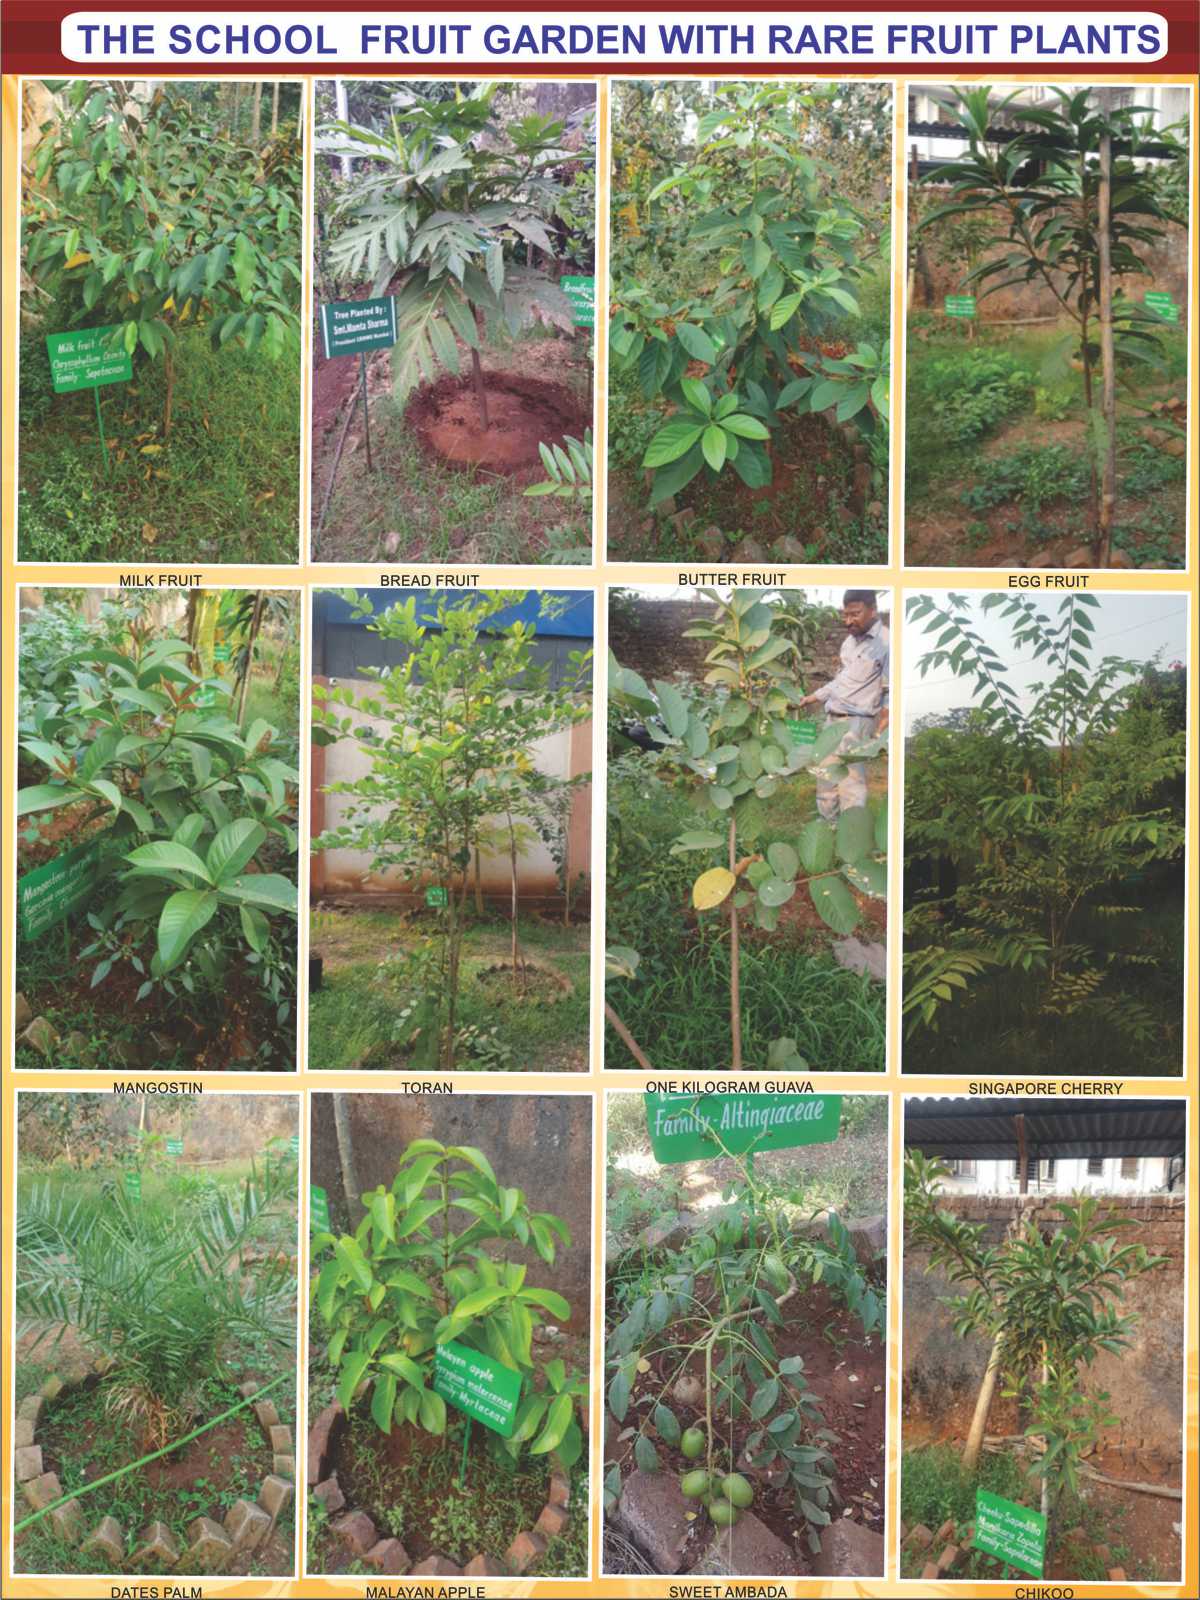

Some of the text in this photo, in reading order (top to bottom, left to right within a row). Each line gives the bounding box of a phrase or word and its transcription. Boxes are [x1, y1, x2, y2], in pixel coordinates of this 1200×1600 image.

[77, 24, 1161, 55] THE SCHOOL FRUIT GARDEN WITH RARE FRUIT PLANTS
[350, 307, 373, 318] Planted
[57, 342, 75, 354] Milk
[119, 574, 202, 587] MILK FRUIT
[380, 574, 480, 587] BREAD FRUIT
[678, 573, 787, 586] BUTTER FRUIT
[1008, 575, 1090, 588] EGG FRUIT
[113, 1081, 203, 1095] MANGOSTIN
[401, 1081, 457, 1095] TORAN
[644, 1081, 814, 1094] ONE KILOGRAM GUAVA
[968, 1082, 1124, 1095] SINGAPORE CHERRY
[111, 1586, 202, 1598] DATES PALM
[366, 1586, 485, 1598] MALAYAN APPLE
[669, 1585, 788, 1598] SWEET AMBADA
[1015, 1587, 1074, 1599] CHIKOO
